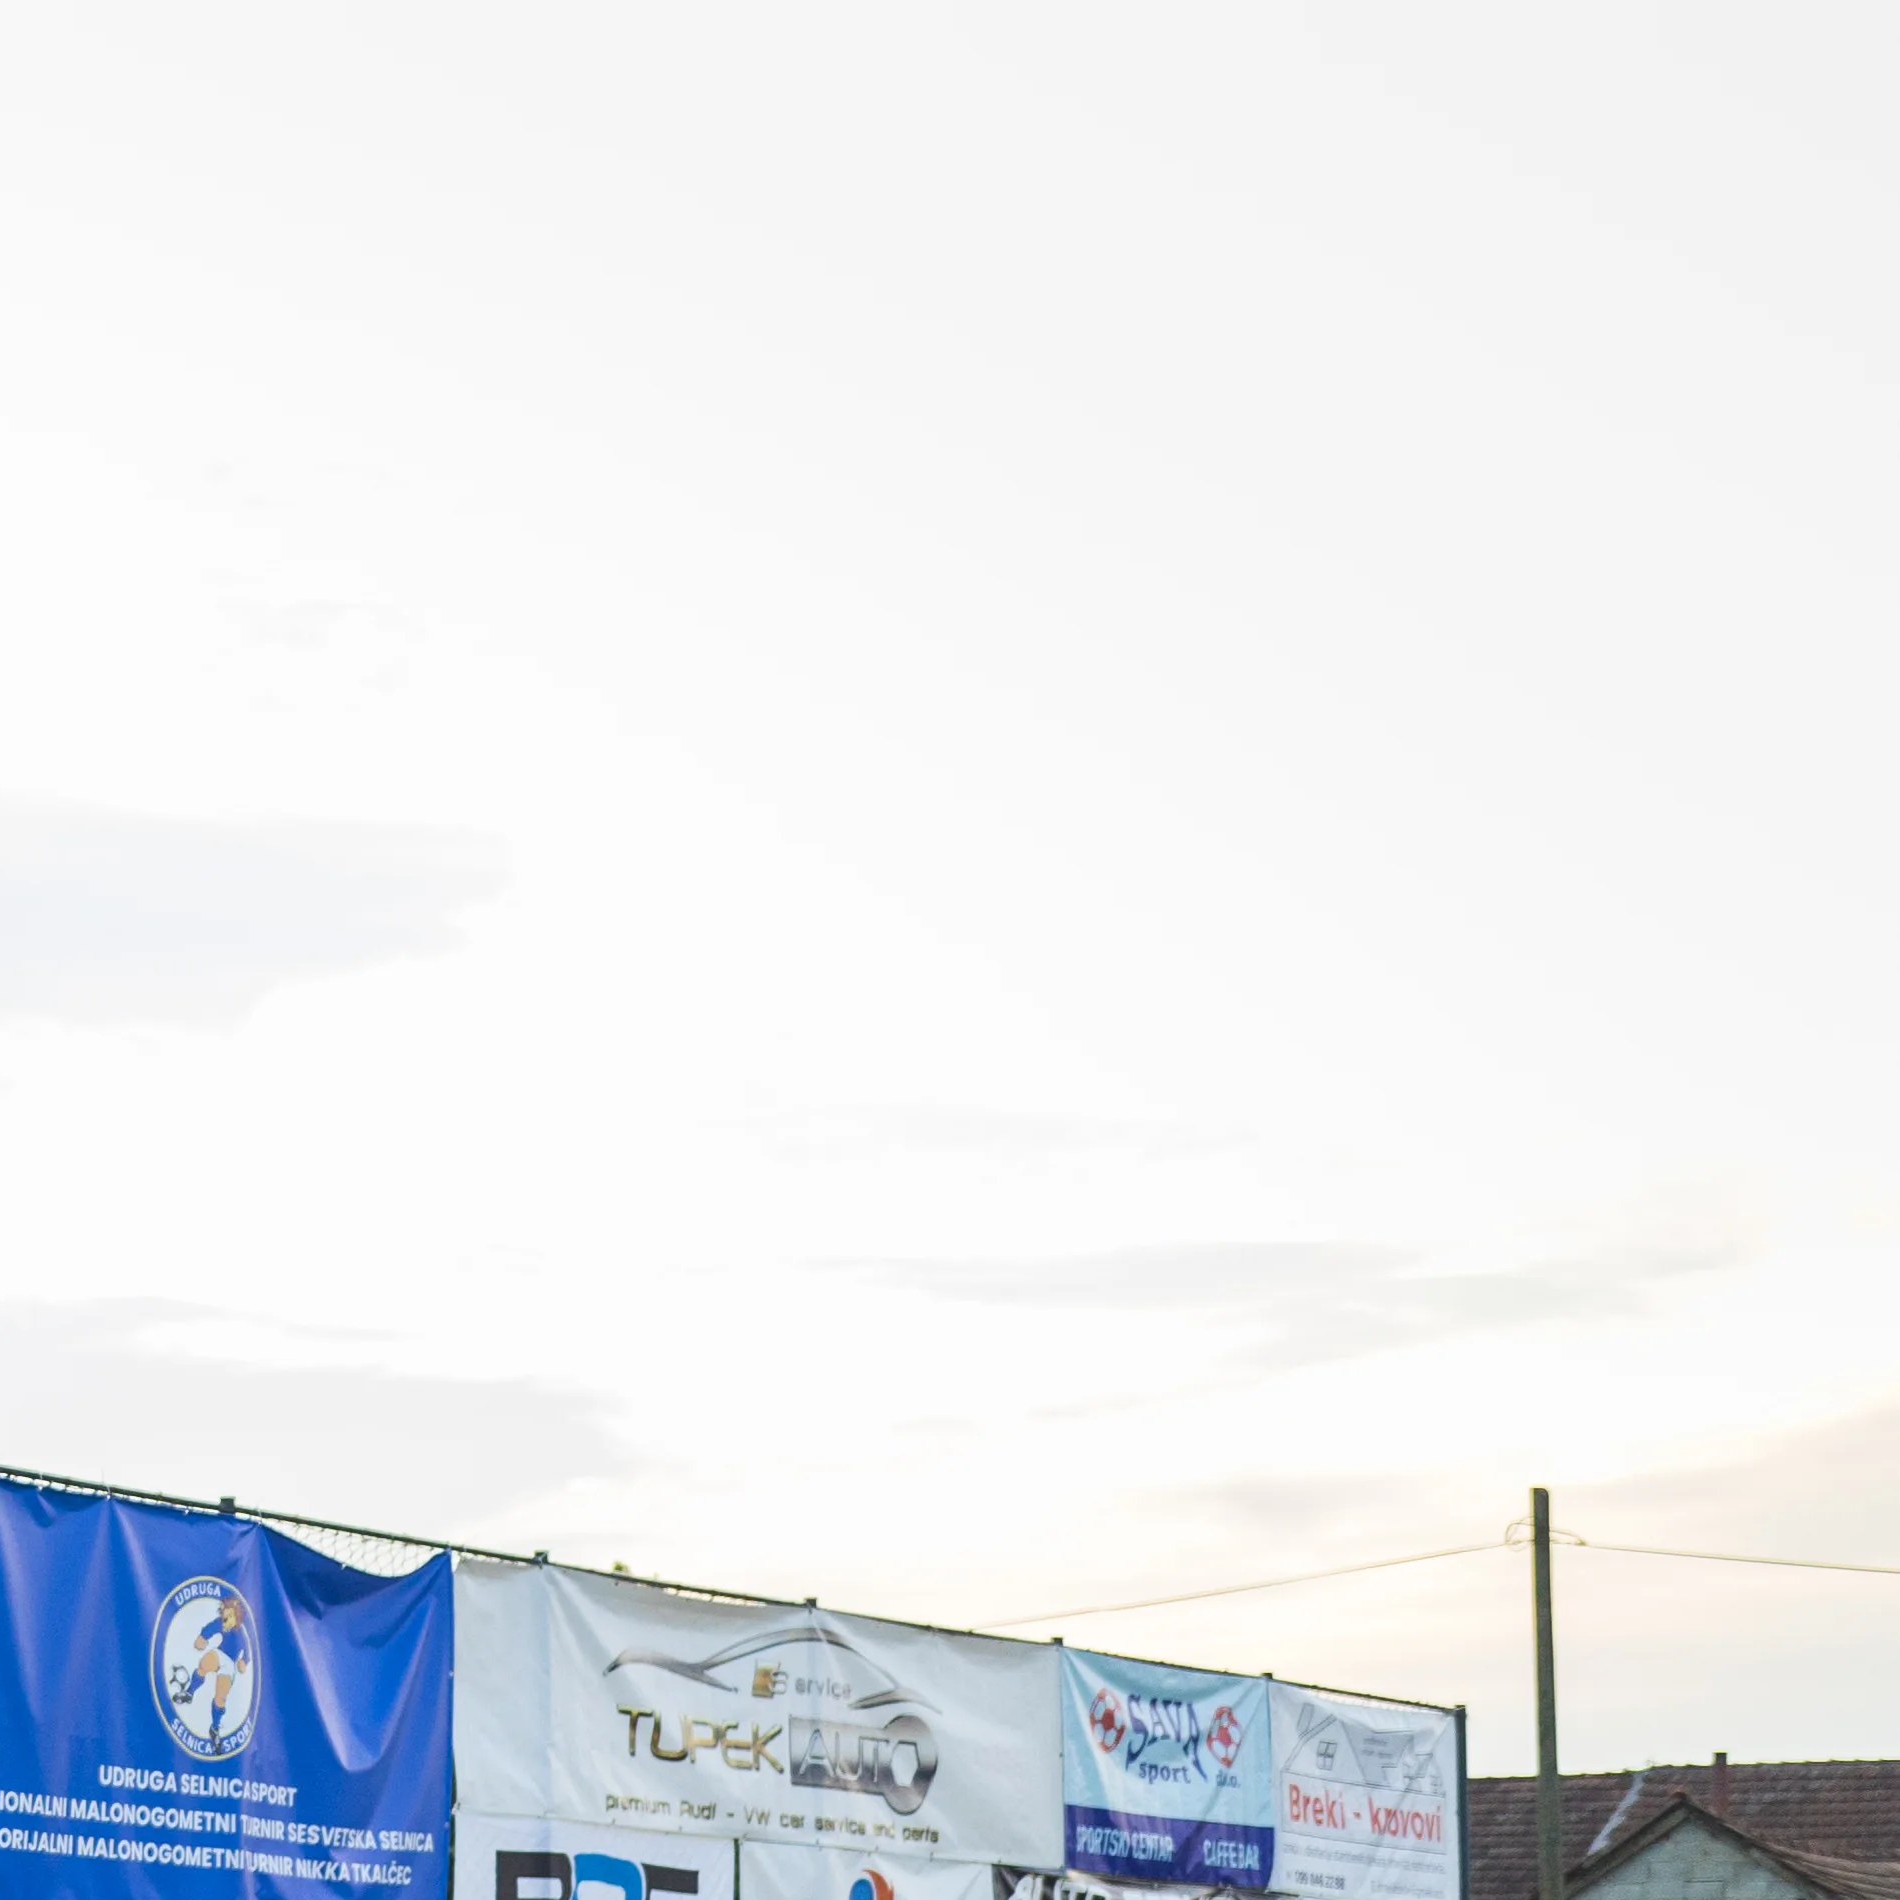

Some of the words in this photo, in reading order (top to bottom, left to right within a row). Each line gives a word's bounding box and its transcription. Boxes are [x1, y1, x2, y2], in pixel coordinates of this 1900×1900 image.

[175, 1582, 222, 1606] UDRUGA
[171, 1718, 213, 1754] SELNICA
[616, 1703, 785, 1775] TUPEK
[799, 1728, 921, 1789] AUTO
[1126, 1692, 1208, 1783] SAVA
[99, 1764, 177, 1794] UDRUGA
[1138, 1761, 1192, 1785] sport
[70, 1798, 237, 1834] MALONOGOMETNI
[287, 1822, 377, 1850] SESVETSKA
[379, 1830, 434, 1852] SELNICA
[605, 1793, 671, 1817] premium
[743, 1806, 771, 1826] VW
[1288, 1783, 1346, 1830] Breki
[1368, 1795, 1443, 1844] krovovi
[77, 1835, 244, 1870] MALONOGOMETNI
[296, 1857, 351, 1882] NIKKA
[351, 1859, 413, 1886] TKALČEC
